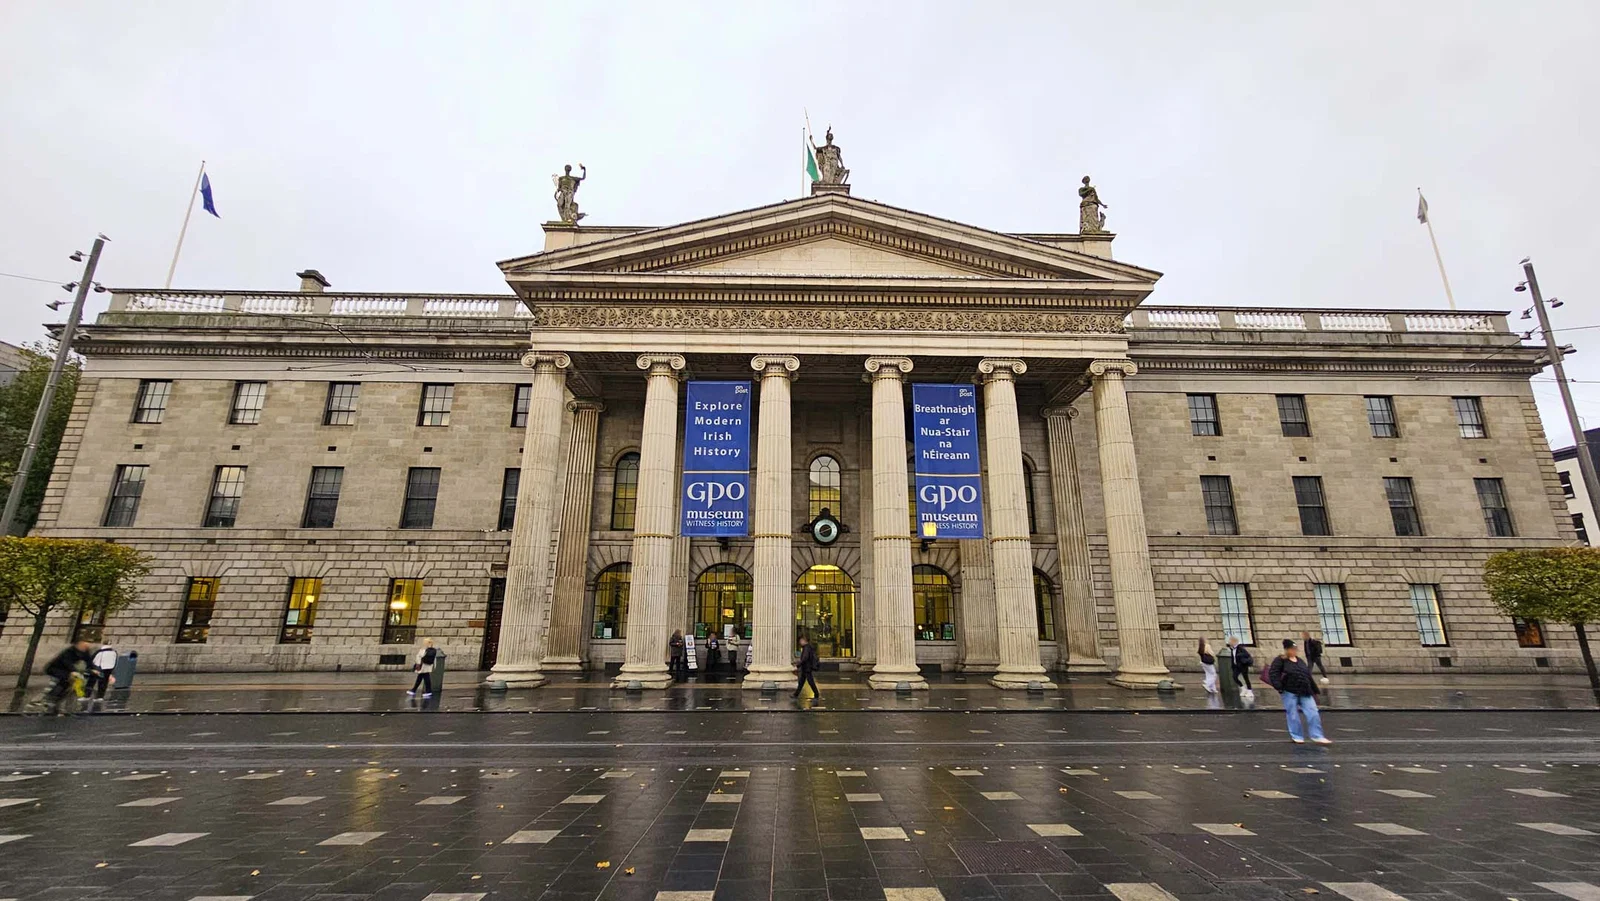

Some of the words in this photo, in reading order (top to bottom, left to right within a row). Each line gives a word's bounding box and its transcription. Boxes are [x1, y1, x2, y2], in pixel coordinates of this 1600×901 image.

[695, 402, 742, 412] Explore
[915, 404, 974, 415] Breathnaigh
[694, 416, 742, 425] Modern
[704, 432, 732, 440] Irish
[921, 428, 970, 436] Nua-Stair
[694, 446, 740, 457] History
[923, 449, 970, 459] hÉireann
[686, 510, 744, 519] museum
[922, 513, 978, 521] museum
